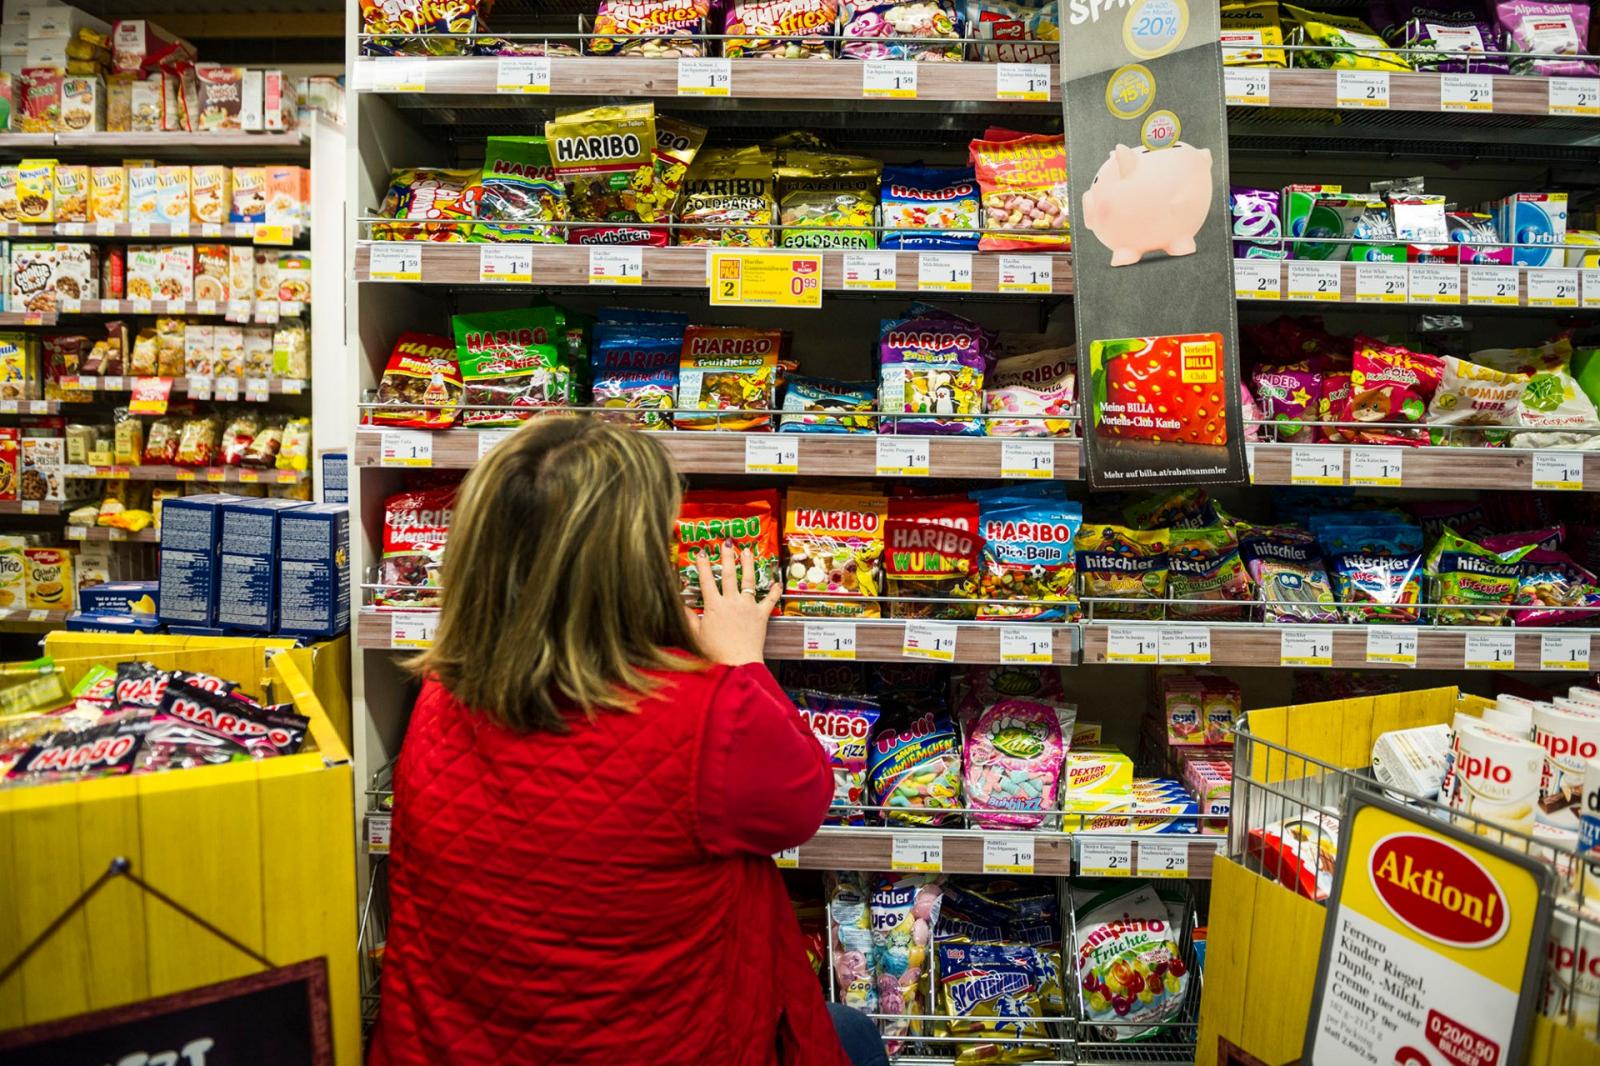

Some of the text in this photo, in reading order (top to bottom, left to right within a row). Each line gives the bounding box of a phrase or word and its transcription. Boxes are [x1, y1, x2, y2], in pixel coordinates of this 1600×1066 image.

[1514, 4, 1574, 16] Alpen Salbei
[1132, 16, 1177, 36] -20%
[1147, 126, 1175, 140] -10%
[556, 133, 641, 162] HARIBO
[493, 160, 557, 182] HARIB
[684, 177, 765, 197] HARIBO
[891, 184, 974, 202] HARIBO
[723, 281, 735, 297] 2
[398, 341, 458, 360] HARIB
[465, 326, 549, 355] HARIBO
[691, 337, 773, 355] HARIBO
[888, 331, 971, 351] HARIBO
[1185, 356, 1212, 369] BILLA
[1190, 371, 1208, 380] Club
[1100, 402, 1155, 413] Meine BILLA
[1100, 415, 1181, 429] Vorteils-Club Karte
[1104, 466, 1228, 480] Mehr auf billa.at/rabattsammler
[391, 508, 452, 530] HARIB
[680, 516, 761, 542] HARIBO
[795, 507, 880, 533] HARIBO
[892, 528, 974, 555] HARIBO
[986, 519, 1072, 544] HARIBO
[995, 545, 1061, 560] Pico-Balla
[1253, 543, 1307, 561] hitschler
[1085, 555, 1154, 571] hitschler
[1170, 556, 1226, 573] itschler
[1343, 555, 1410, 572] hitschler
[800, 710, 870, 739] ARIBO
[876, 712, 937, 755] Trolli
[842, 744, 866, 757] FIZZ
[1529, 723, 1598, 759] duplo
[1069, 764, 1107, 778] DEXTRO
[1457, 750, 1513, 784] uplo
[1073, 771, 1107, 786] ENERGY
[872, 886, 910, 905] schler
[1375, 849, 1498, 929] Aktion!
[1342, 919, 1387, 955] Ferrero
[1089, 932, 1149, 965] Früchte
[1340, 934, 1427, 995] Kinder Riegel,
[1334, 969, 1423, 1029] creme 10er oder
[1379, 977, 1425, 1011] -Milch-
[1331, 981, 1400, 1033] Country 9er
[1324, 1024, 1341, 1040] statt
[1339, 1019, 1374, 1049] Packung
[1430, 1017, 1495, 1063] 0.20/0.50
[1438, 1039, 1480, 1066] BILLIGER
